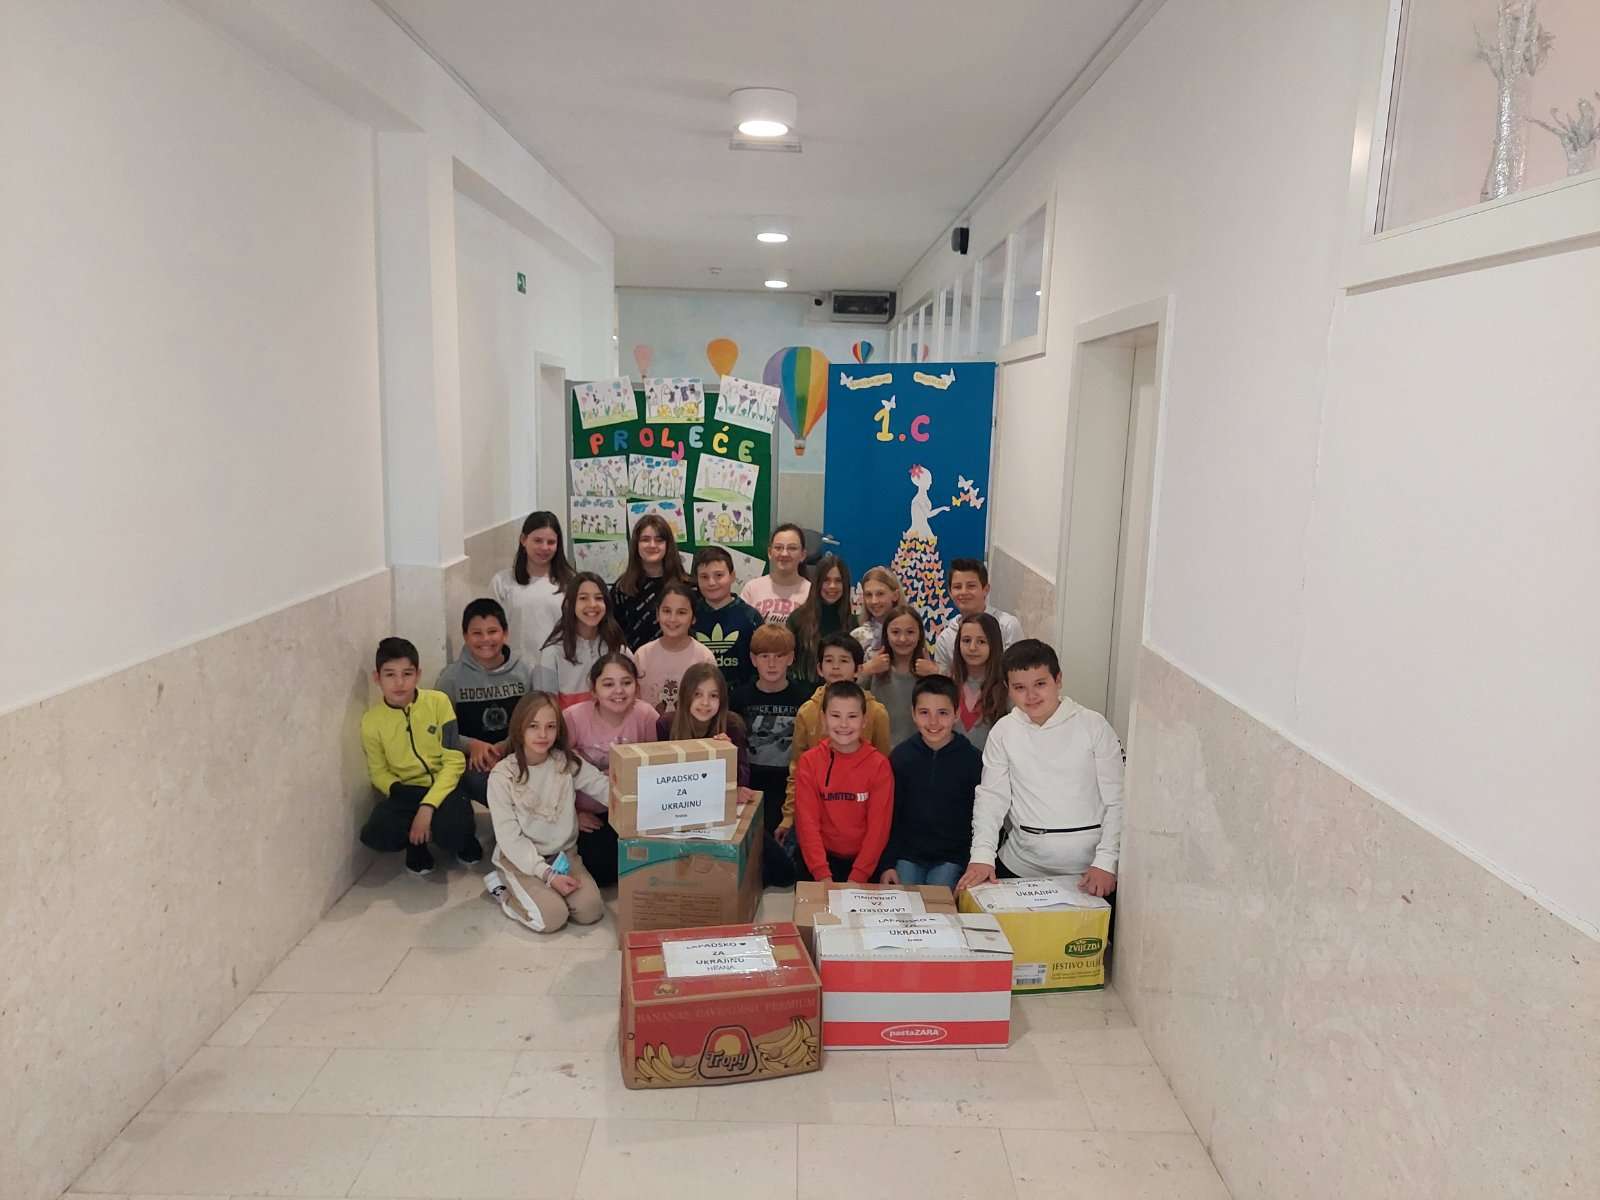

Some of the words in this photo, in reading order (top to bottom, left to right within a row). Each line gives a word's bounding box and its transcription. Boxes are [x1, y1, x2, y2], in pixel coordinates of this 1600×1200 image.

[656, 773, 700, 785] LAPADSKO
[676, 788, 687, 796] ZA
[661, 799, 702, 811] UKRAJINU
[889, 928, 937, 936] UKRAJINU
[695, 957, 745, 965] UKRAJINU
[705, 1048, 750, 1072] Tropy
